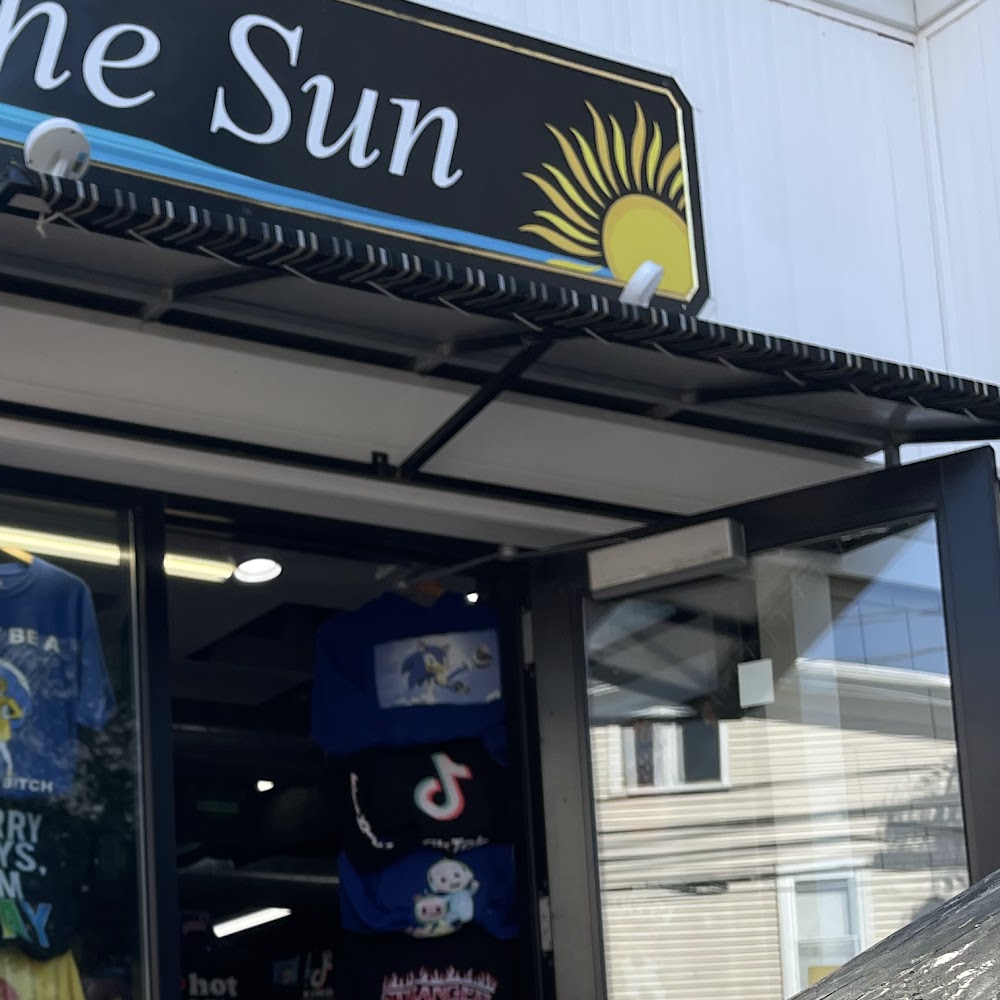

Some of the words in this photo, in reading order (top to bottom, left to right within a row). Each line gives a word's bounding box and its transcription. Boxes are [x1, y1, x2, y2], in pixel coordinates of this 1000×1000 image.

[209, 11, 464, 190] Sun
[8, 627, 38, 646] BE
[43, 635, 61, 653] A
[188, 971, 239, 997] hot
